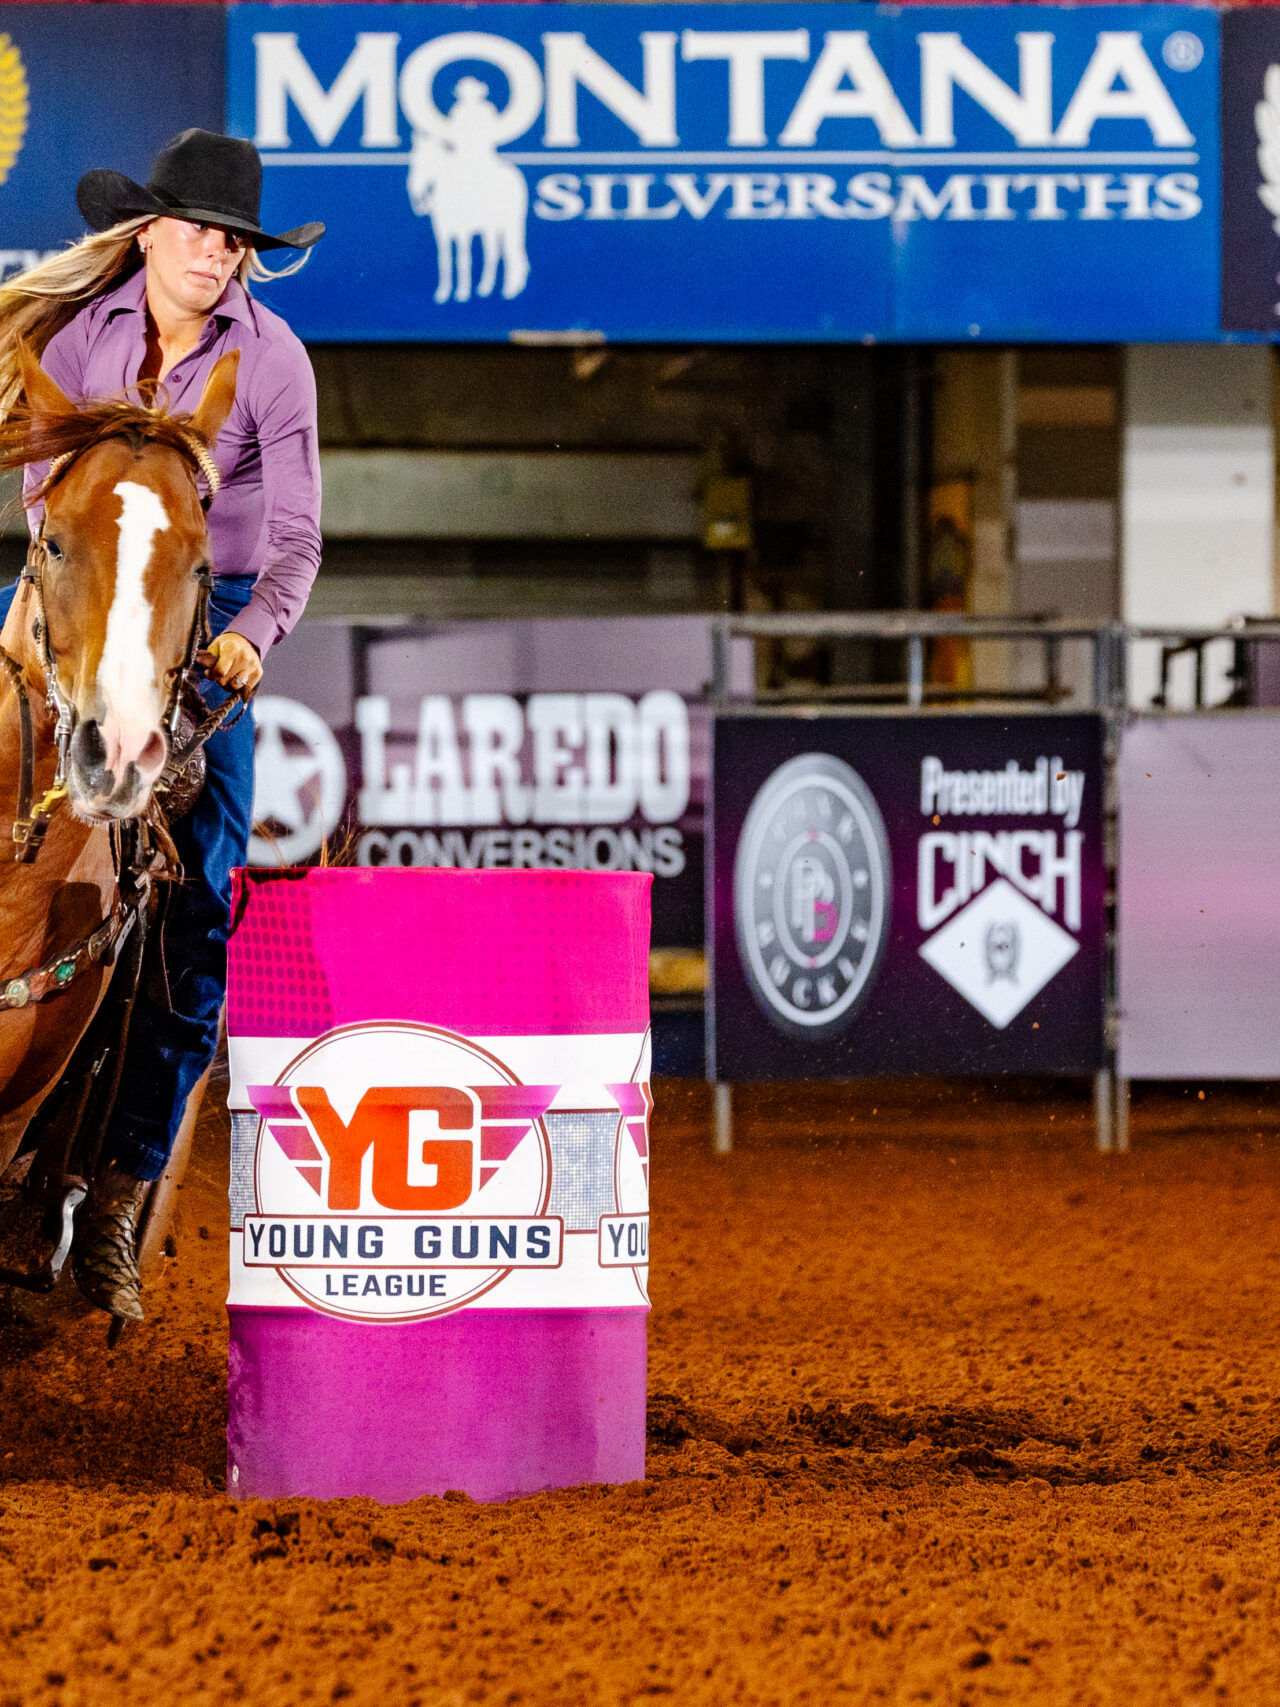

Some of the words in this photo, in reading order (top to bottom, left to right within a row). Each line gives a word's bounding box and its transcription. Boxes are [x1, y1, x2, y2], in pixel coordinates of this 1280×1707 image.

[253, 29, 1196, 148] MONTANA
[533, 172, 1204, 220] SILVERSMITHS
[354, 689, 691, 826] LAREDO
[922, 756, 1049, 815] Presented
[1050, 756, 1086, 828] by
[356, 826, 687, 878] CONVERSIONS
[918, 830, 1083, 932] CINCH
[296, 1086, 474, 1210] YG
[249, 1223, 383, 1259] YOUNG
[414, 1225, 551, 1259] GUNS
[325, 1274, 447, 1297] LEAGUE
